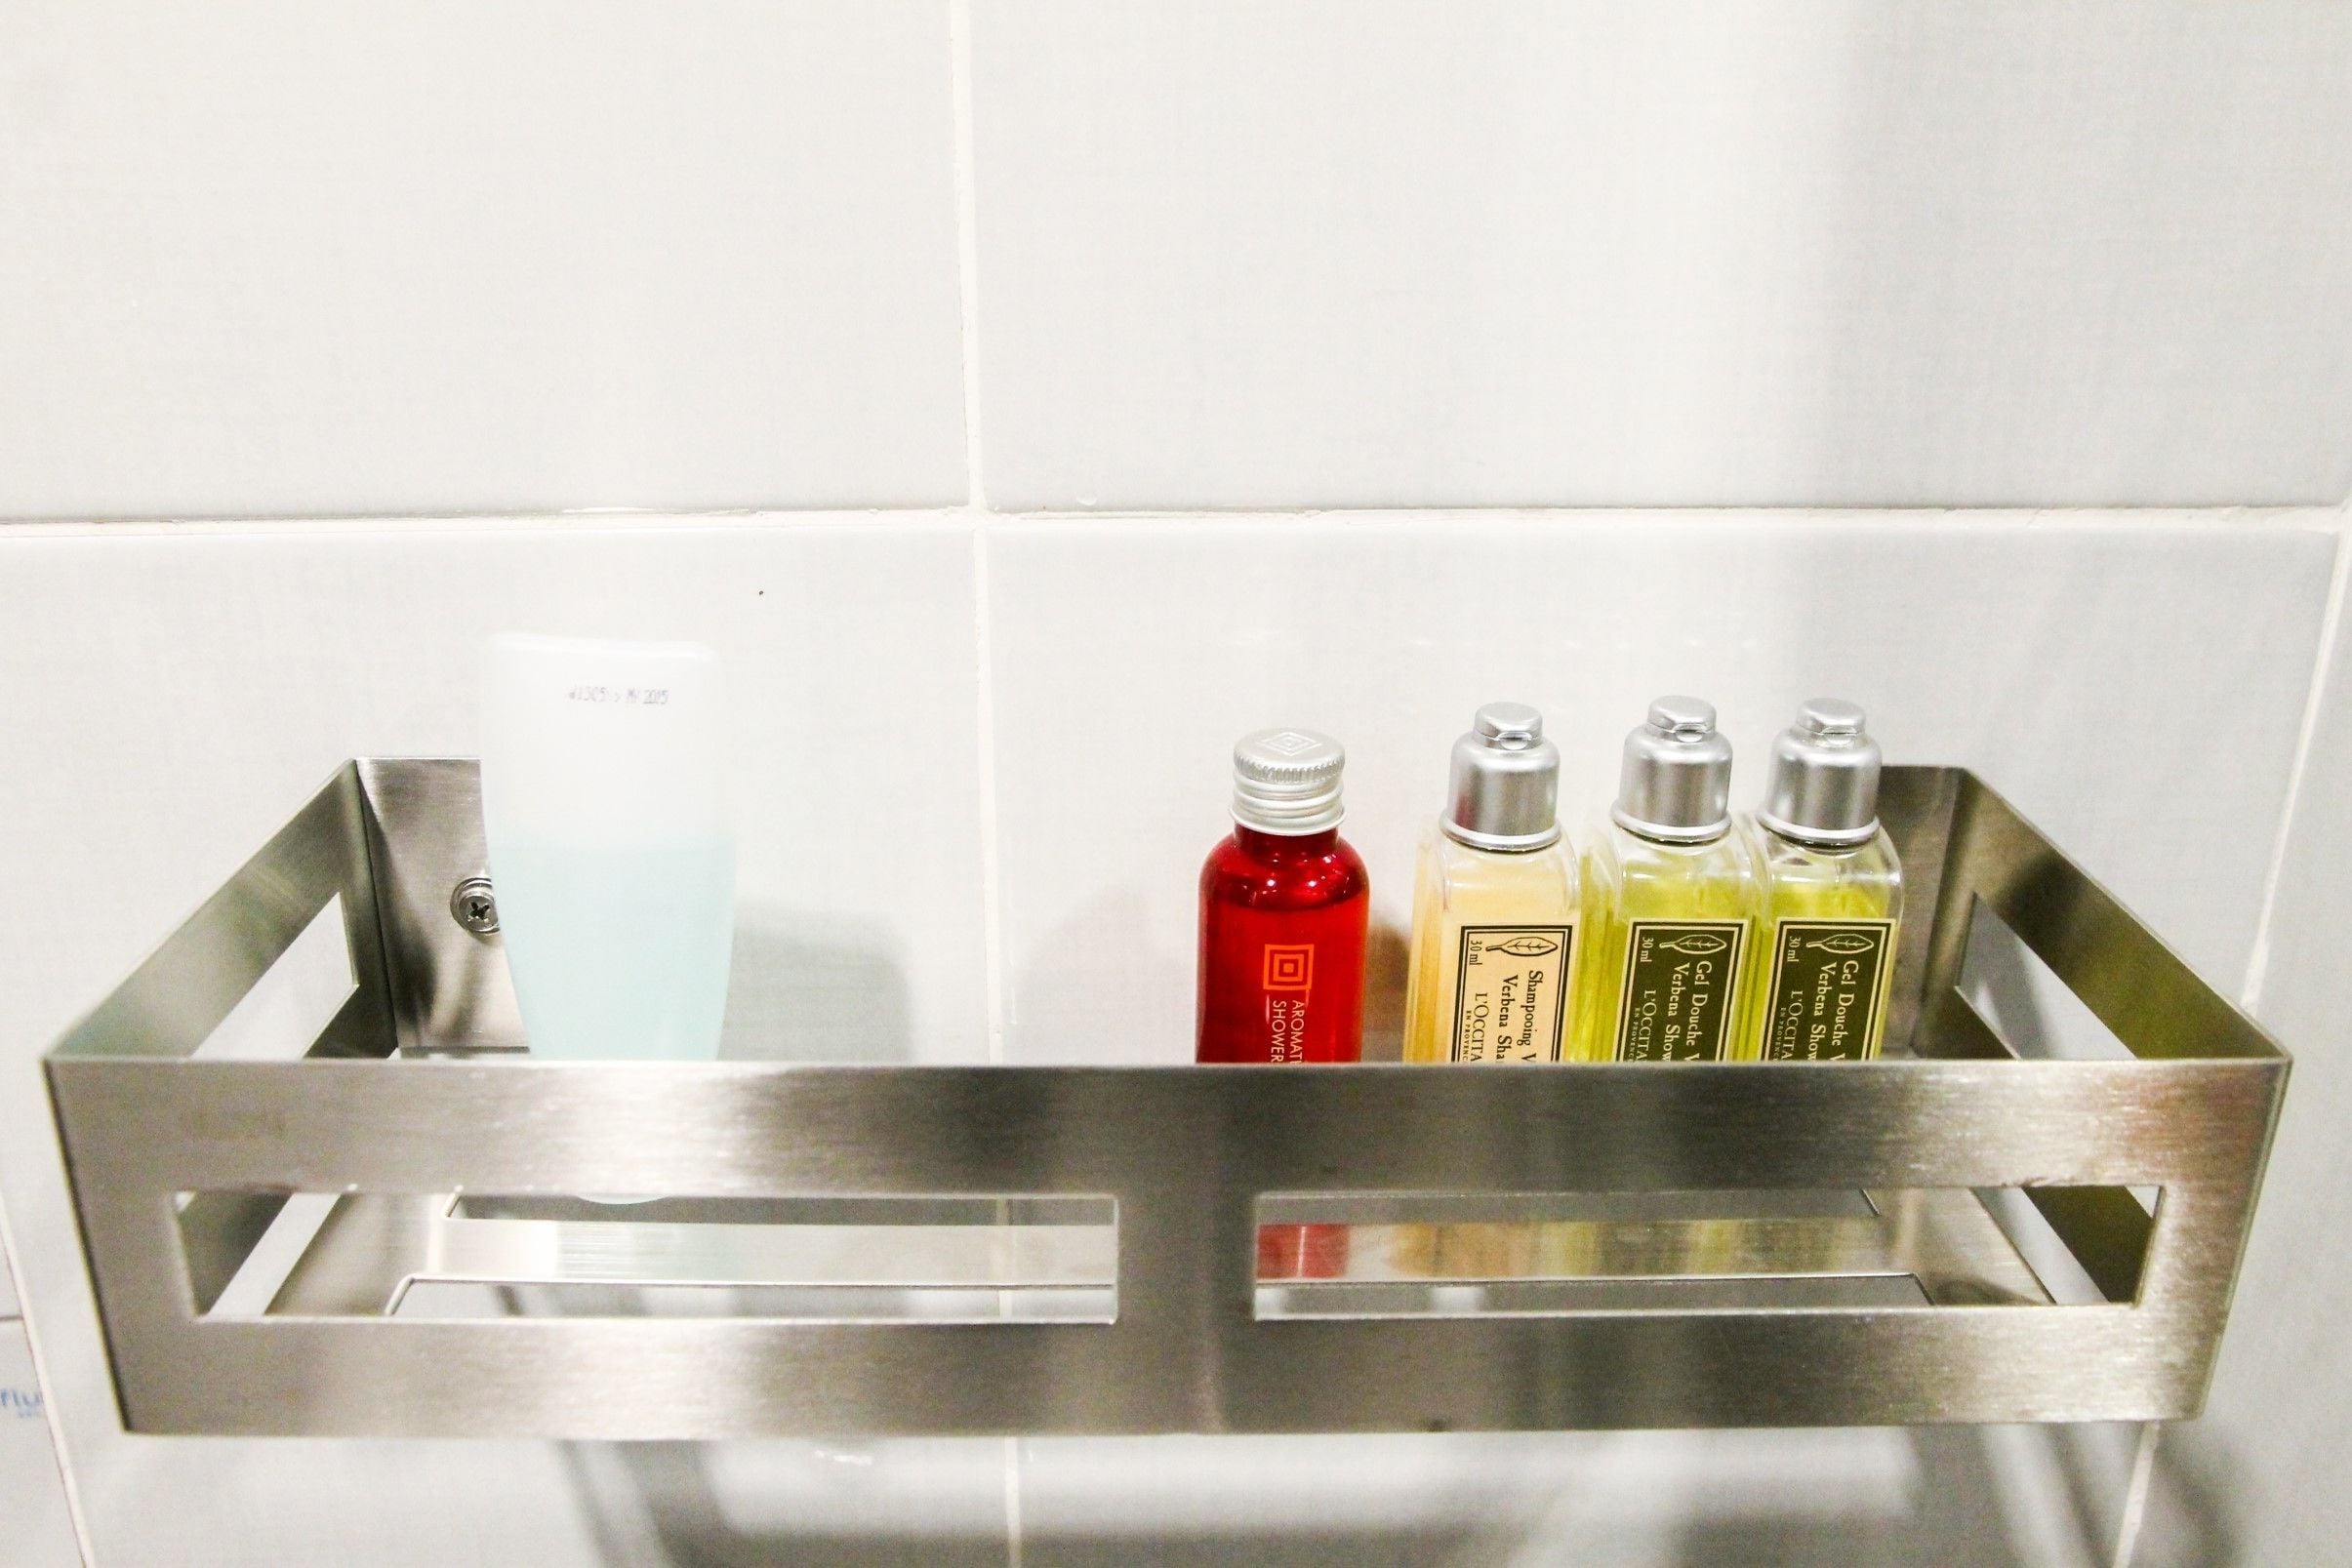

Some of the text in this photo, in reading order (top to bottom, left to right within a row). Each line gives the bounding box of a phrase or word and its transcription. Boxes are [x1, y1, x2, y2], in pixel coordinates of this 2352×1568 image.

[1469, 940, 1482, 966] 30 ml
[1640, 937, 1654, 963] 30 ml
[1694, 960, 1713, 985] Gel
[1787, 936, 1802, 963] 30 ml
[1841, 960, 1859, 985] Gel
[1517, 970, 1544, 1047] Shampooing
[1667, 962, 1690, 1017] Verbena
[1813, 961, 1838, 1017] Verbena
[1271, 1000, 1287, 1063] SHOWER
[1496, 975, 1519, 1063] Verbena Sha
[1685, 993, 1708, 1046] Douche
[1831, 993, 1854, 1046] Douche
